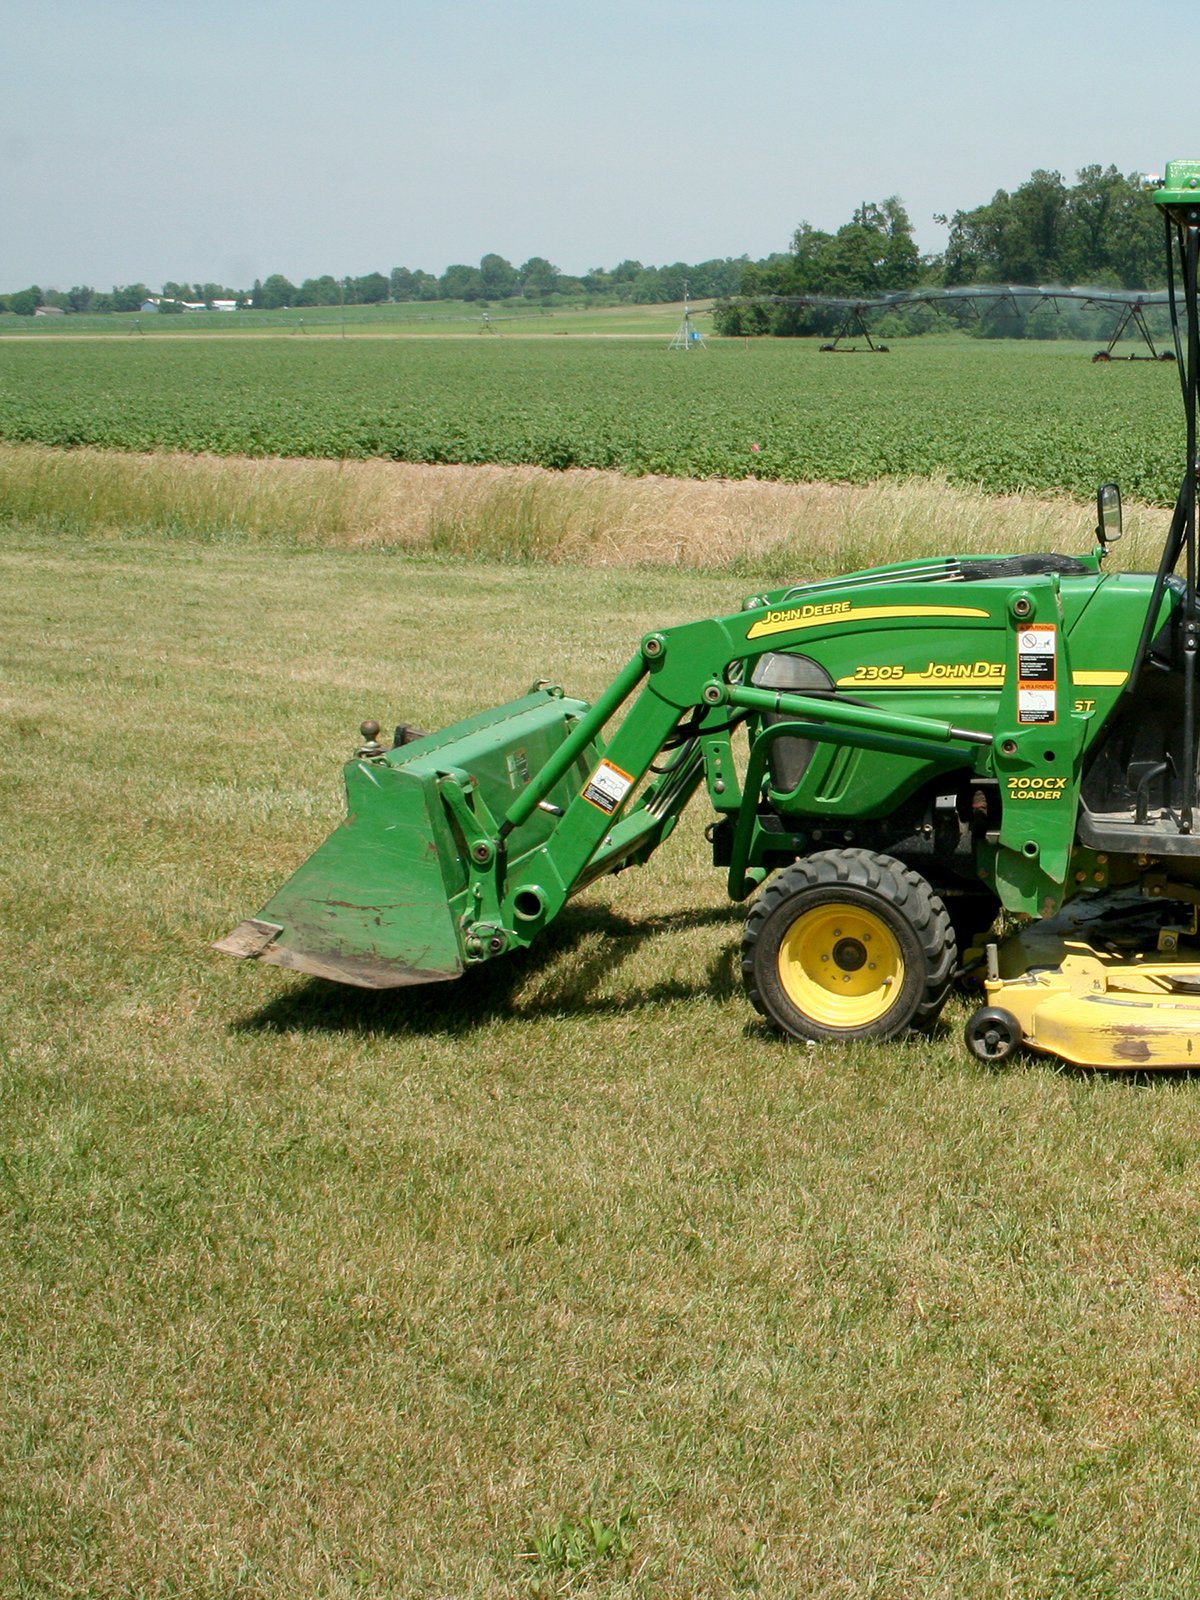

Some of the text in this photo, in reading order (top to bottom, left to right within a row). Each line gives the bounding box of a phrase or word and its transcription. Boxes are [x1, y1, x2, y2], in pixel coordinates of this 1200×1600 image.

[761, 601, 851, 624] JOHN DEERE
[854, 666, 904, 680] 2305
[920, 662, 972, 677] JOHN
[1007, 777, 1067, 789] 200CX
[1010, 790, 1062, 799] LOADER
